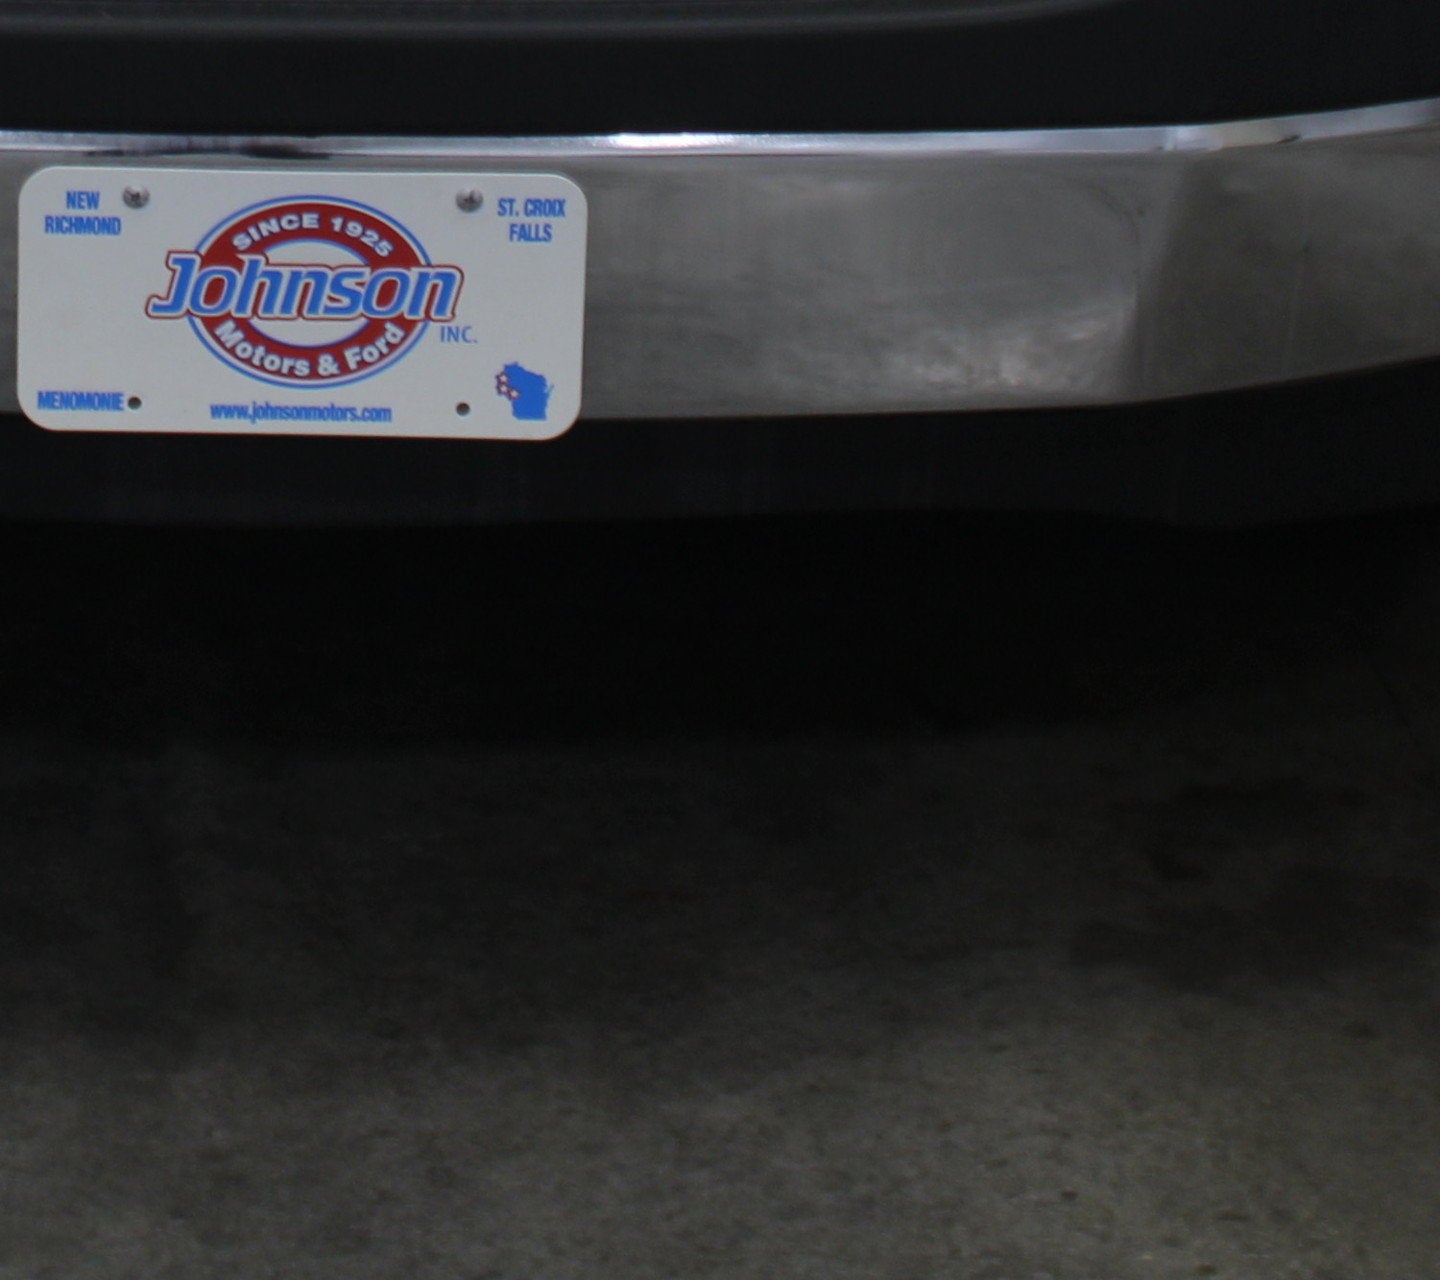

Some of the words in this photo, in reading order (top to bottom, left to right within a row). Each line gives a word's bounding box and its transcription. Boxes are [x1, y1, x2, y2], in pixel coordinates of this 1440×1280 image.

[66, 191, 100, 210] NEW
[497, 198, 520, 217] ST.
[523, 198, 566, 217] CROIX
[44, 215, 122, 236] RICHMOND
[232, 212, 320, 251] SINCE
[330, 216, 395, 258] 1925
[509, 223, 553, 242] FALLS
[146, 252, 462, 320] Johnson
[439, 325, 479, 344] INC.
[214, 319, 311, 377] Motors
[317, 354, 341, 377] &
[343, 320, 406, 371] Ford
[37, 391, 124, 412] MENOMONIE
[210, 401, 393, 424] www.johnsonmotors.com
